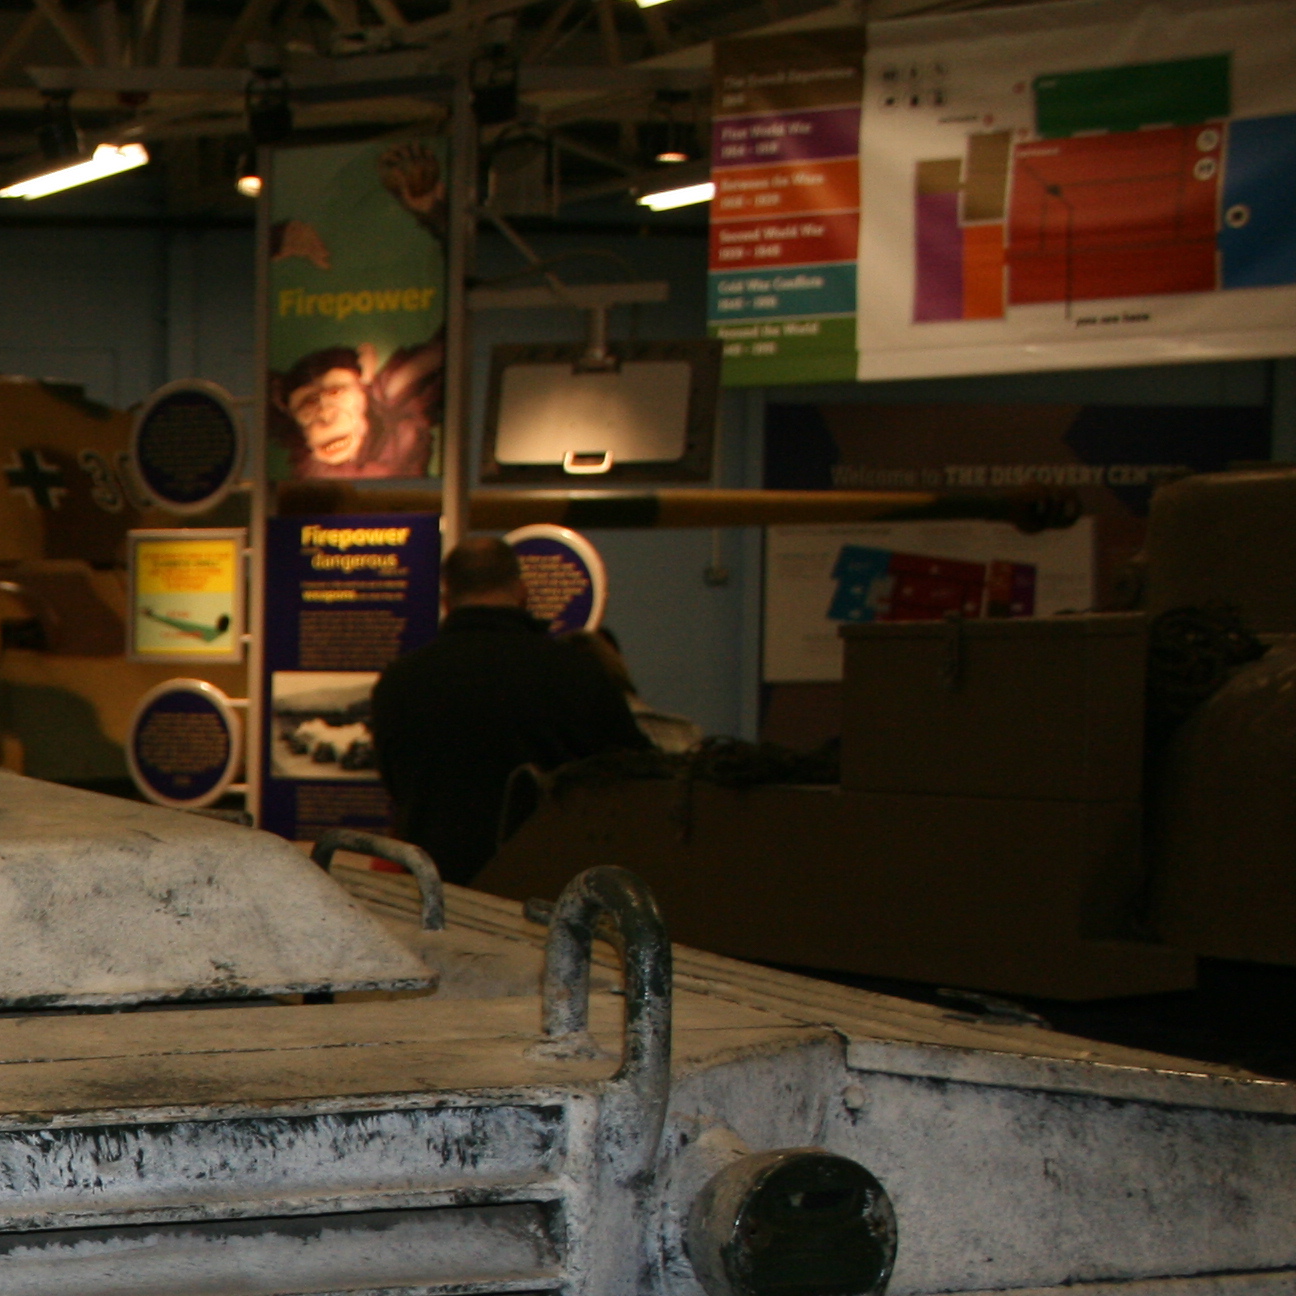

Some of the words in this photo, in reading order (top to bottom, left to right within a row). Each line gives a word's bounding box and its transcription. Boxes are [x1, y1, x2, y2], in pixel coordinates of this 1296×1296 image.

[720, 126, 748, 141] First
[750, 121, 786, 138] World
[787, 121, 812, 135] War
[719, 228, 760, 244] Second
[762, 225, 798, 241] World
[800, 222, 826, 238] War
[717, 280, 744, 295] Cold
[746, 278, 772, 292] War
[278, 286, 436, 321] Firepower
[760, 324, 781, 336] the
[783, 320, 820, 335] World
[1075, 316, 1097, 328] you
[1099, 314, 1118, 323] are
[1119, 310, 1150, 323] here
[944, 465, 986, 487] THE
[989, 464, 1103, 487] DISCOVERY
[301, 524, 413, 551] Firepower
[310, 553, 400, 574] dangerous
